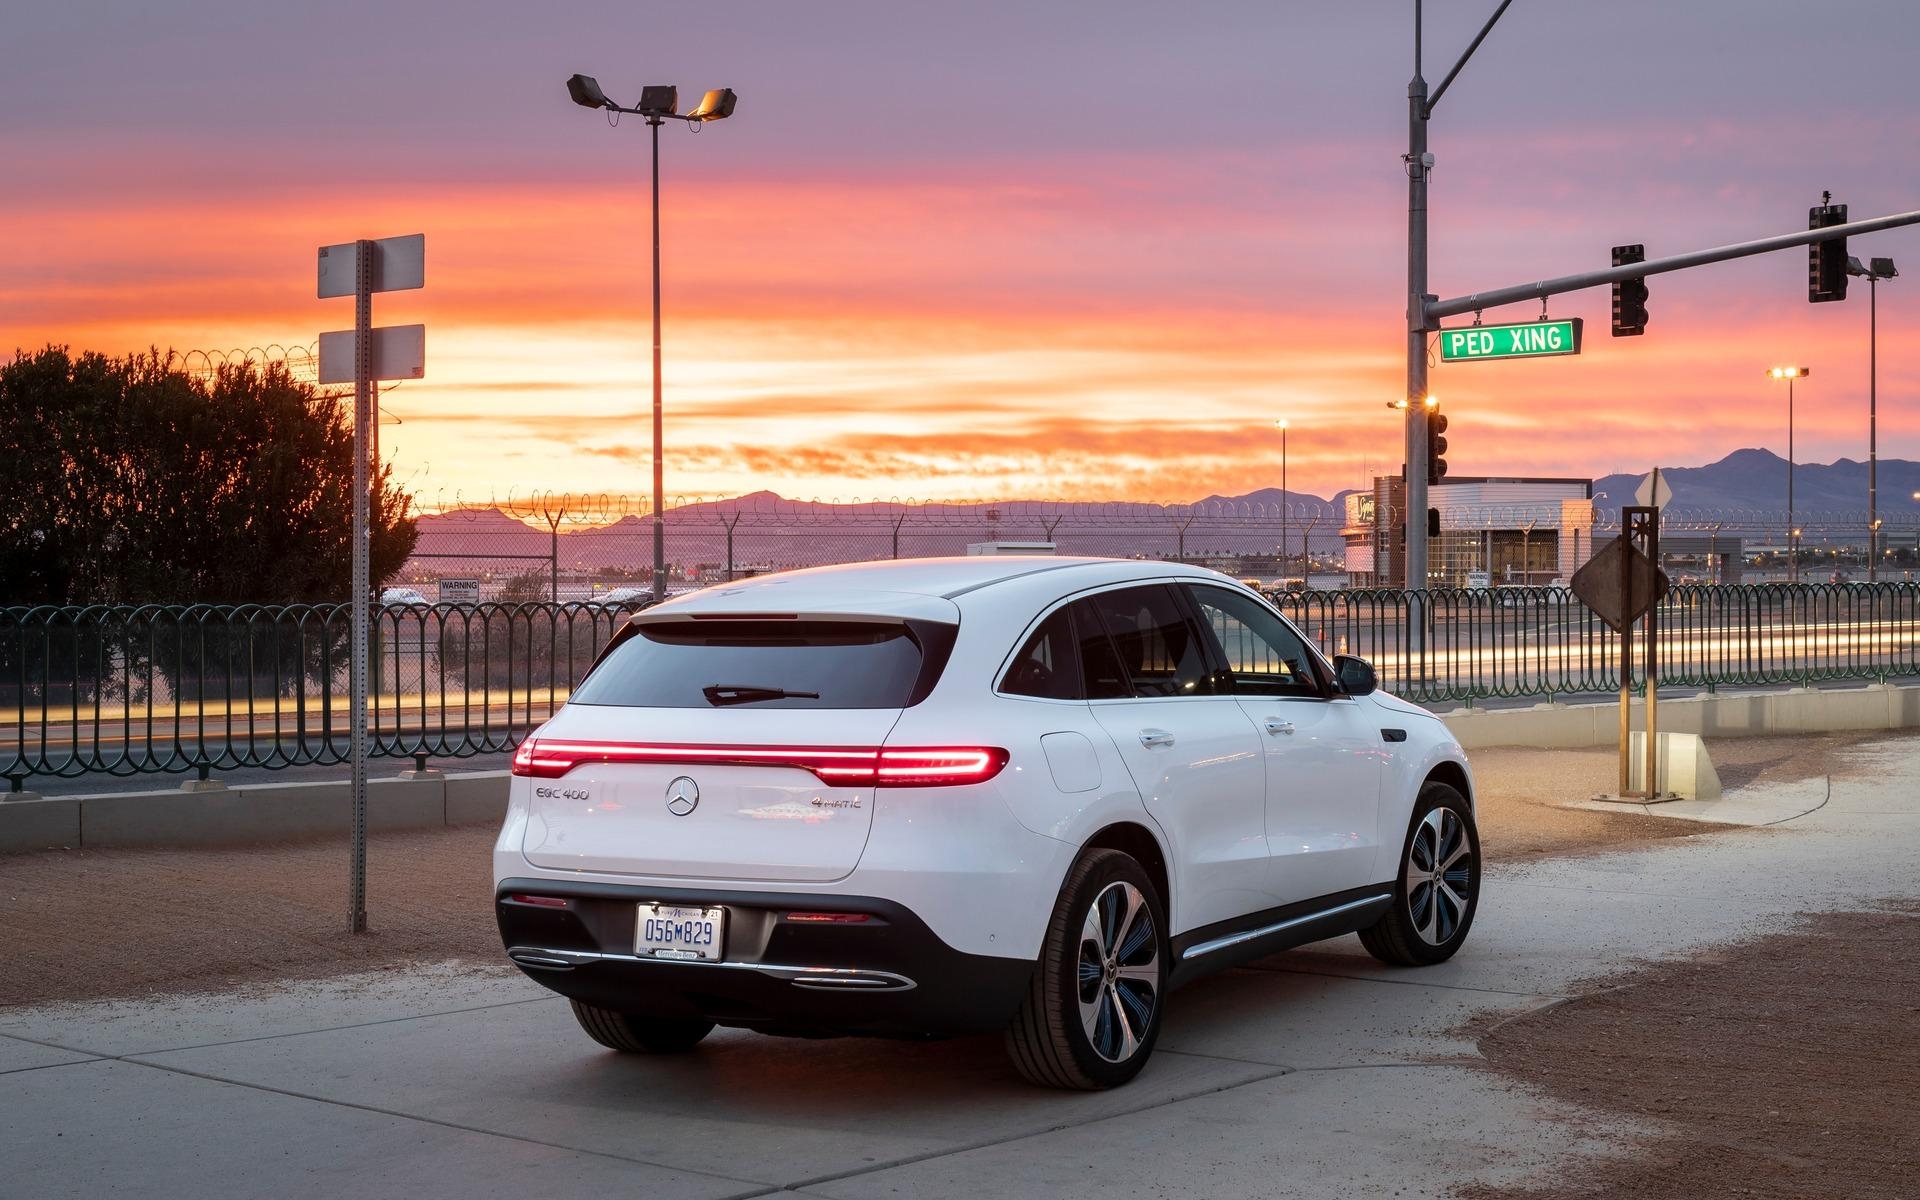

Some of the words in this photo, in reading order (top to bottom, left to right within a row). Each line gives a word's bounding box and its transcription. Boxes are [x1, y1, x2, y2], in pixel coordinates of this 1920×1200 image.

[1451, 333, 1494, 356] PED
[1510, 326, 1562, 353] XING
[441, 581, 478, 589] WARNING
[536, 787, 561, 799] EQC
[563, 788, 590, 801] 400
[645, 919, 713, 945] 056M829
